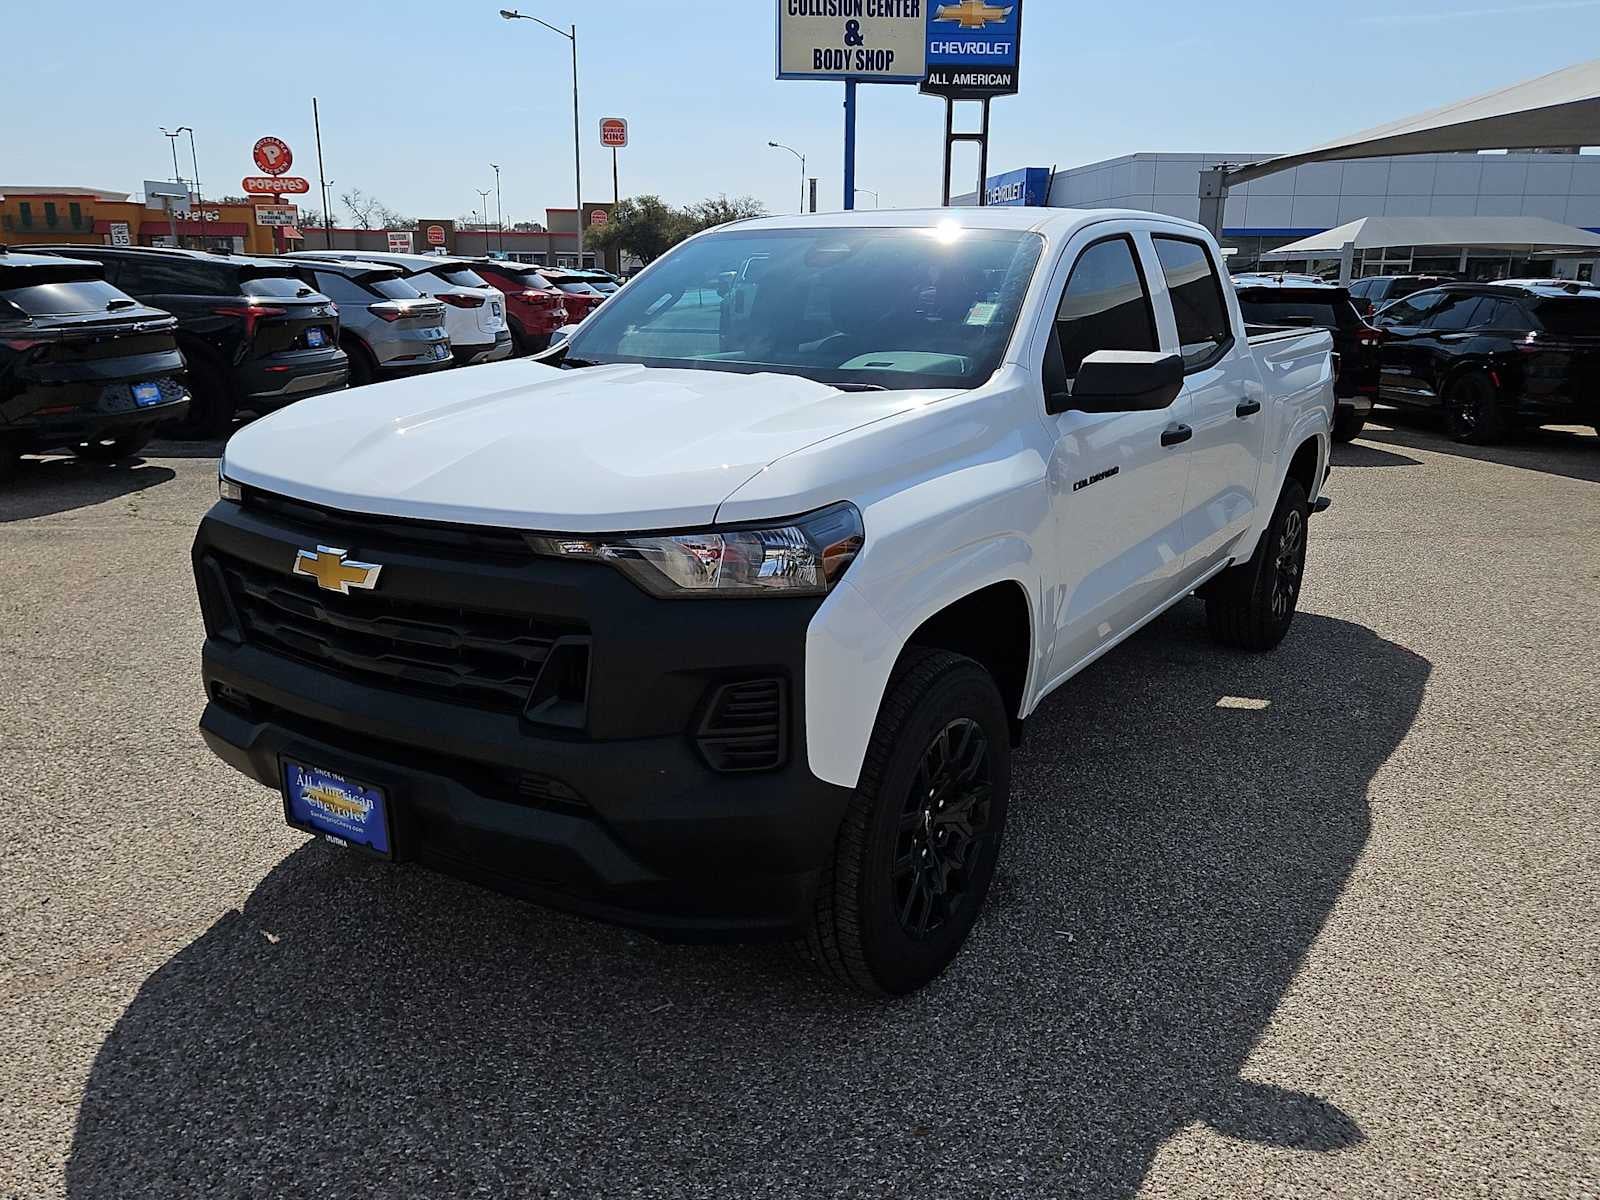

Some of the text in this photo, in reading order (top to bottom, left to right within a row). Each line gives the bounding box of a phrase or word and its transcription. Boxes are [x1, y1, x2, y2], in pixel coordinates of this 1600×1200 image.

[788, 0, 920, 18] COLLISION CENTER
[844, 19, 864, 46] &
[813, 48, 894, 71] BODY SHOP
[930, 41, 1012, 55] CHEVROLET
[928, 72, 1012, 86] ALL AMERICAN
[986, 182, 1023, 206] CHEVROLET
[114, 235, 129, 244] 35
[1073, 466, 1120, 492] COLORADO
[296, 774, 375, 811] All American
[306, 793, 369, 824] Chevrolet
